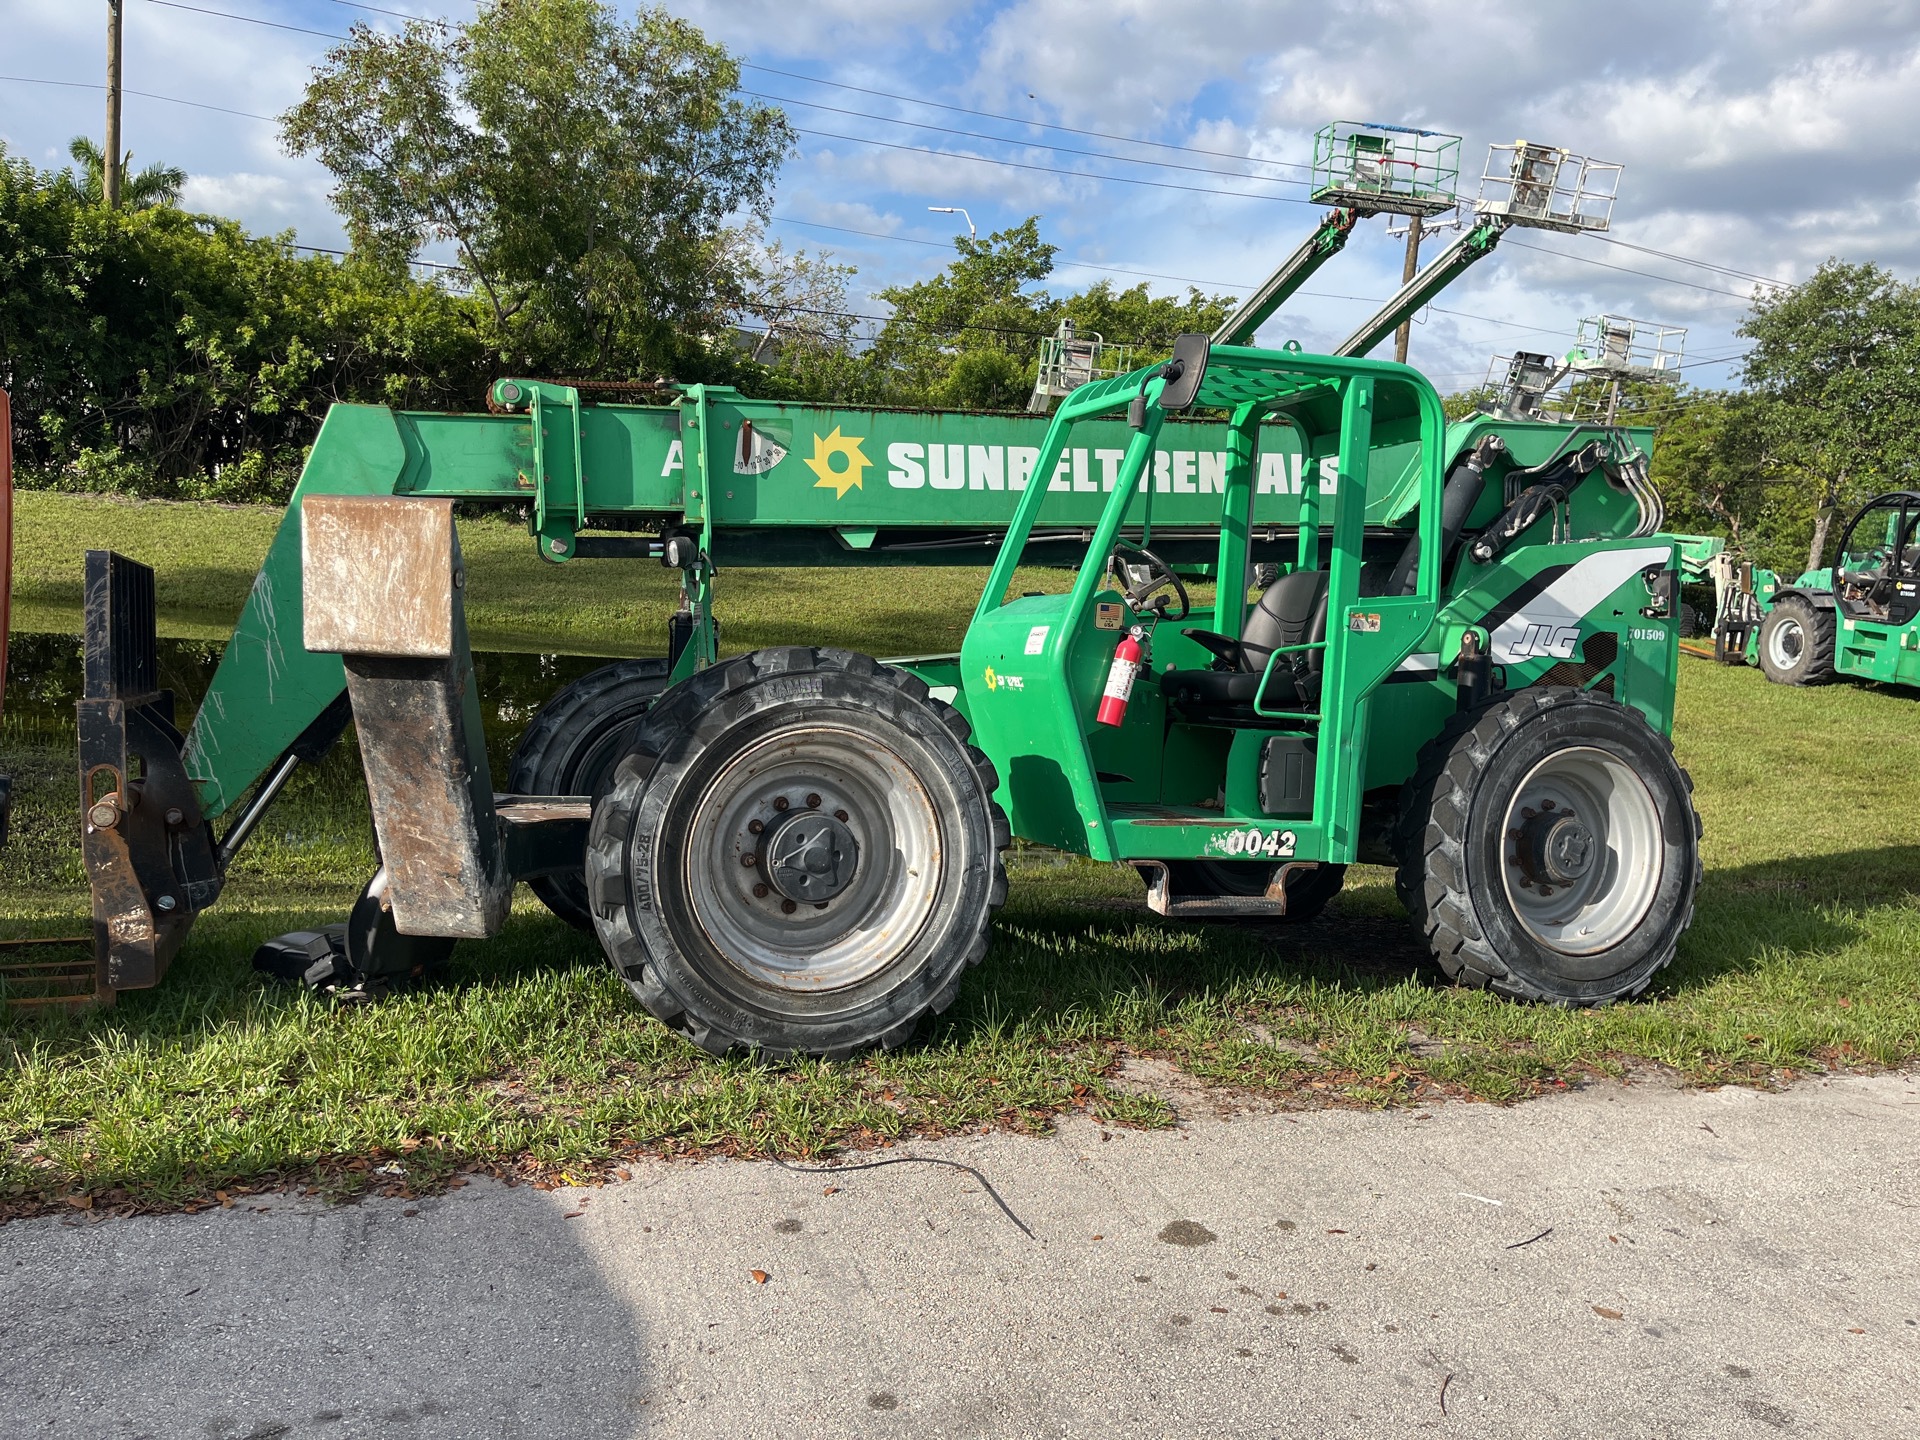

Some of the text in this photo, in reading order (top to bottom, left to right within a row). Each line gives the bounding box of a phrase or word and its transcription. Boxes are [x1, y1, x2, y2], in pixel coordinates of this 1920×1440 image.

[887, 442, 1339, 495] SUNBELT RENALS
[1509, 624, 1582, 659] JLG
[1629, 628, 1665, 641] 701509
[763, 677, 824, 699] CAMSO
[635, 834, 652, 911] 400/75-28
